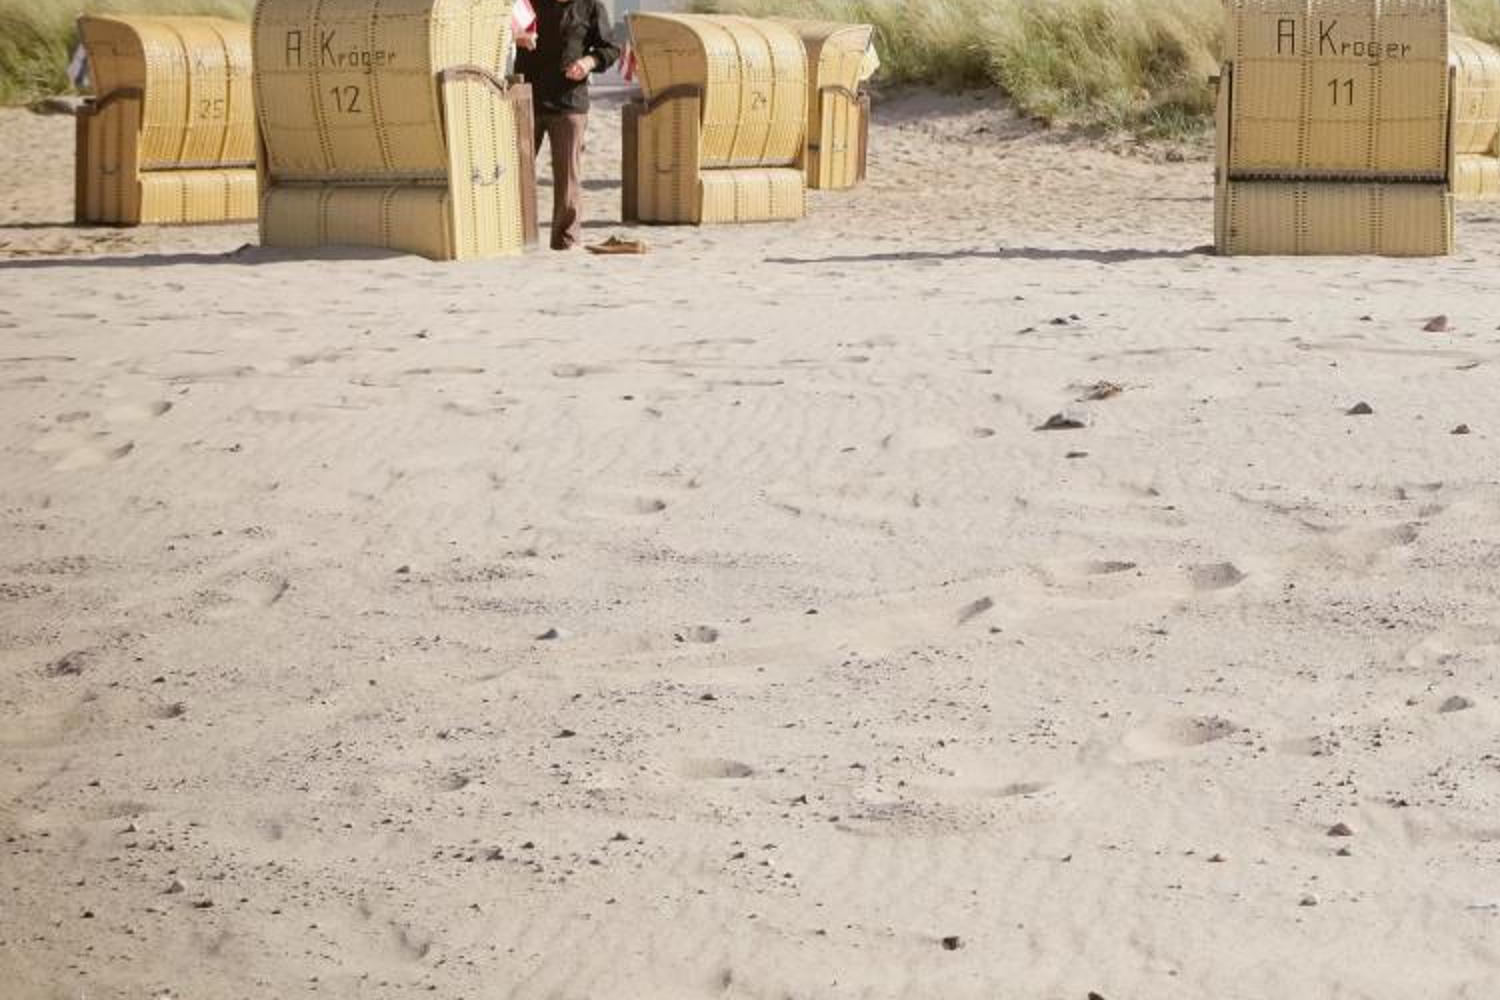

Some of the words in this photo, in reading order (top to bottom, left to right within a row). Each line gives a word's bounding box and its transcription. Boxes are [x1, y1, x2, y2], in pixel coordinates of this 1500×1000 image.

[286, 29, 302, 67] A
[1277, 19, 1295, 56] A
[330, 85, 362, 113] 12
[1327, 78, 1355, 105] 11
